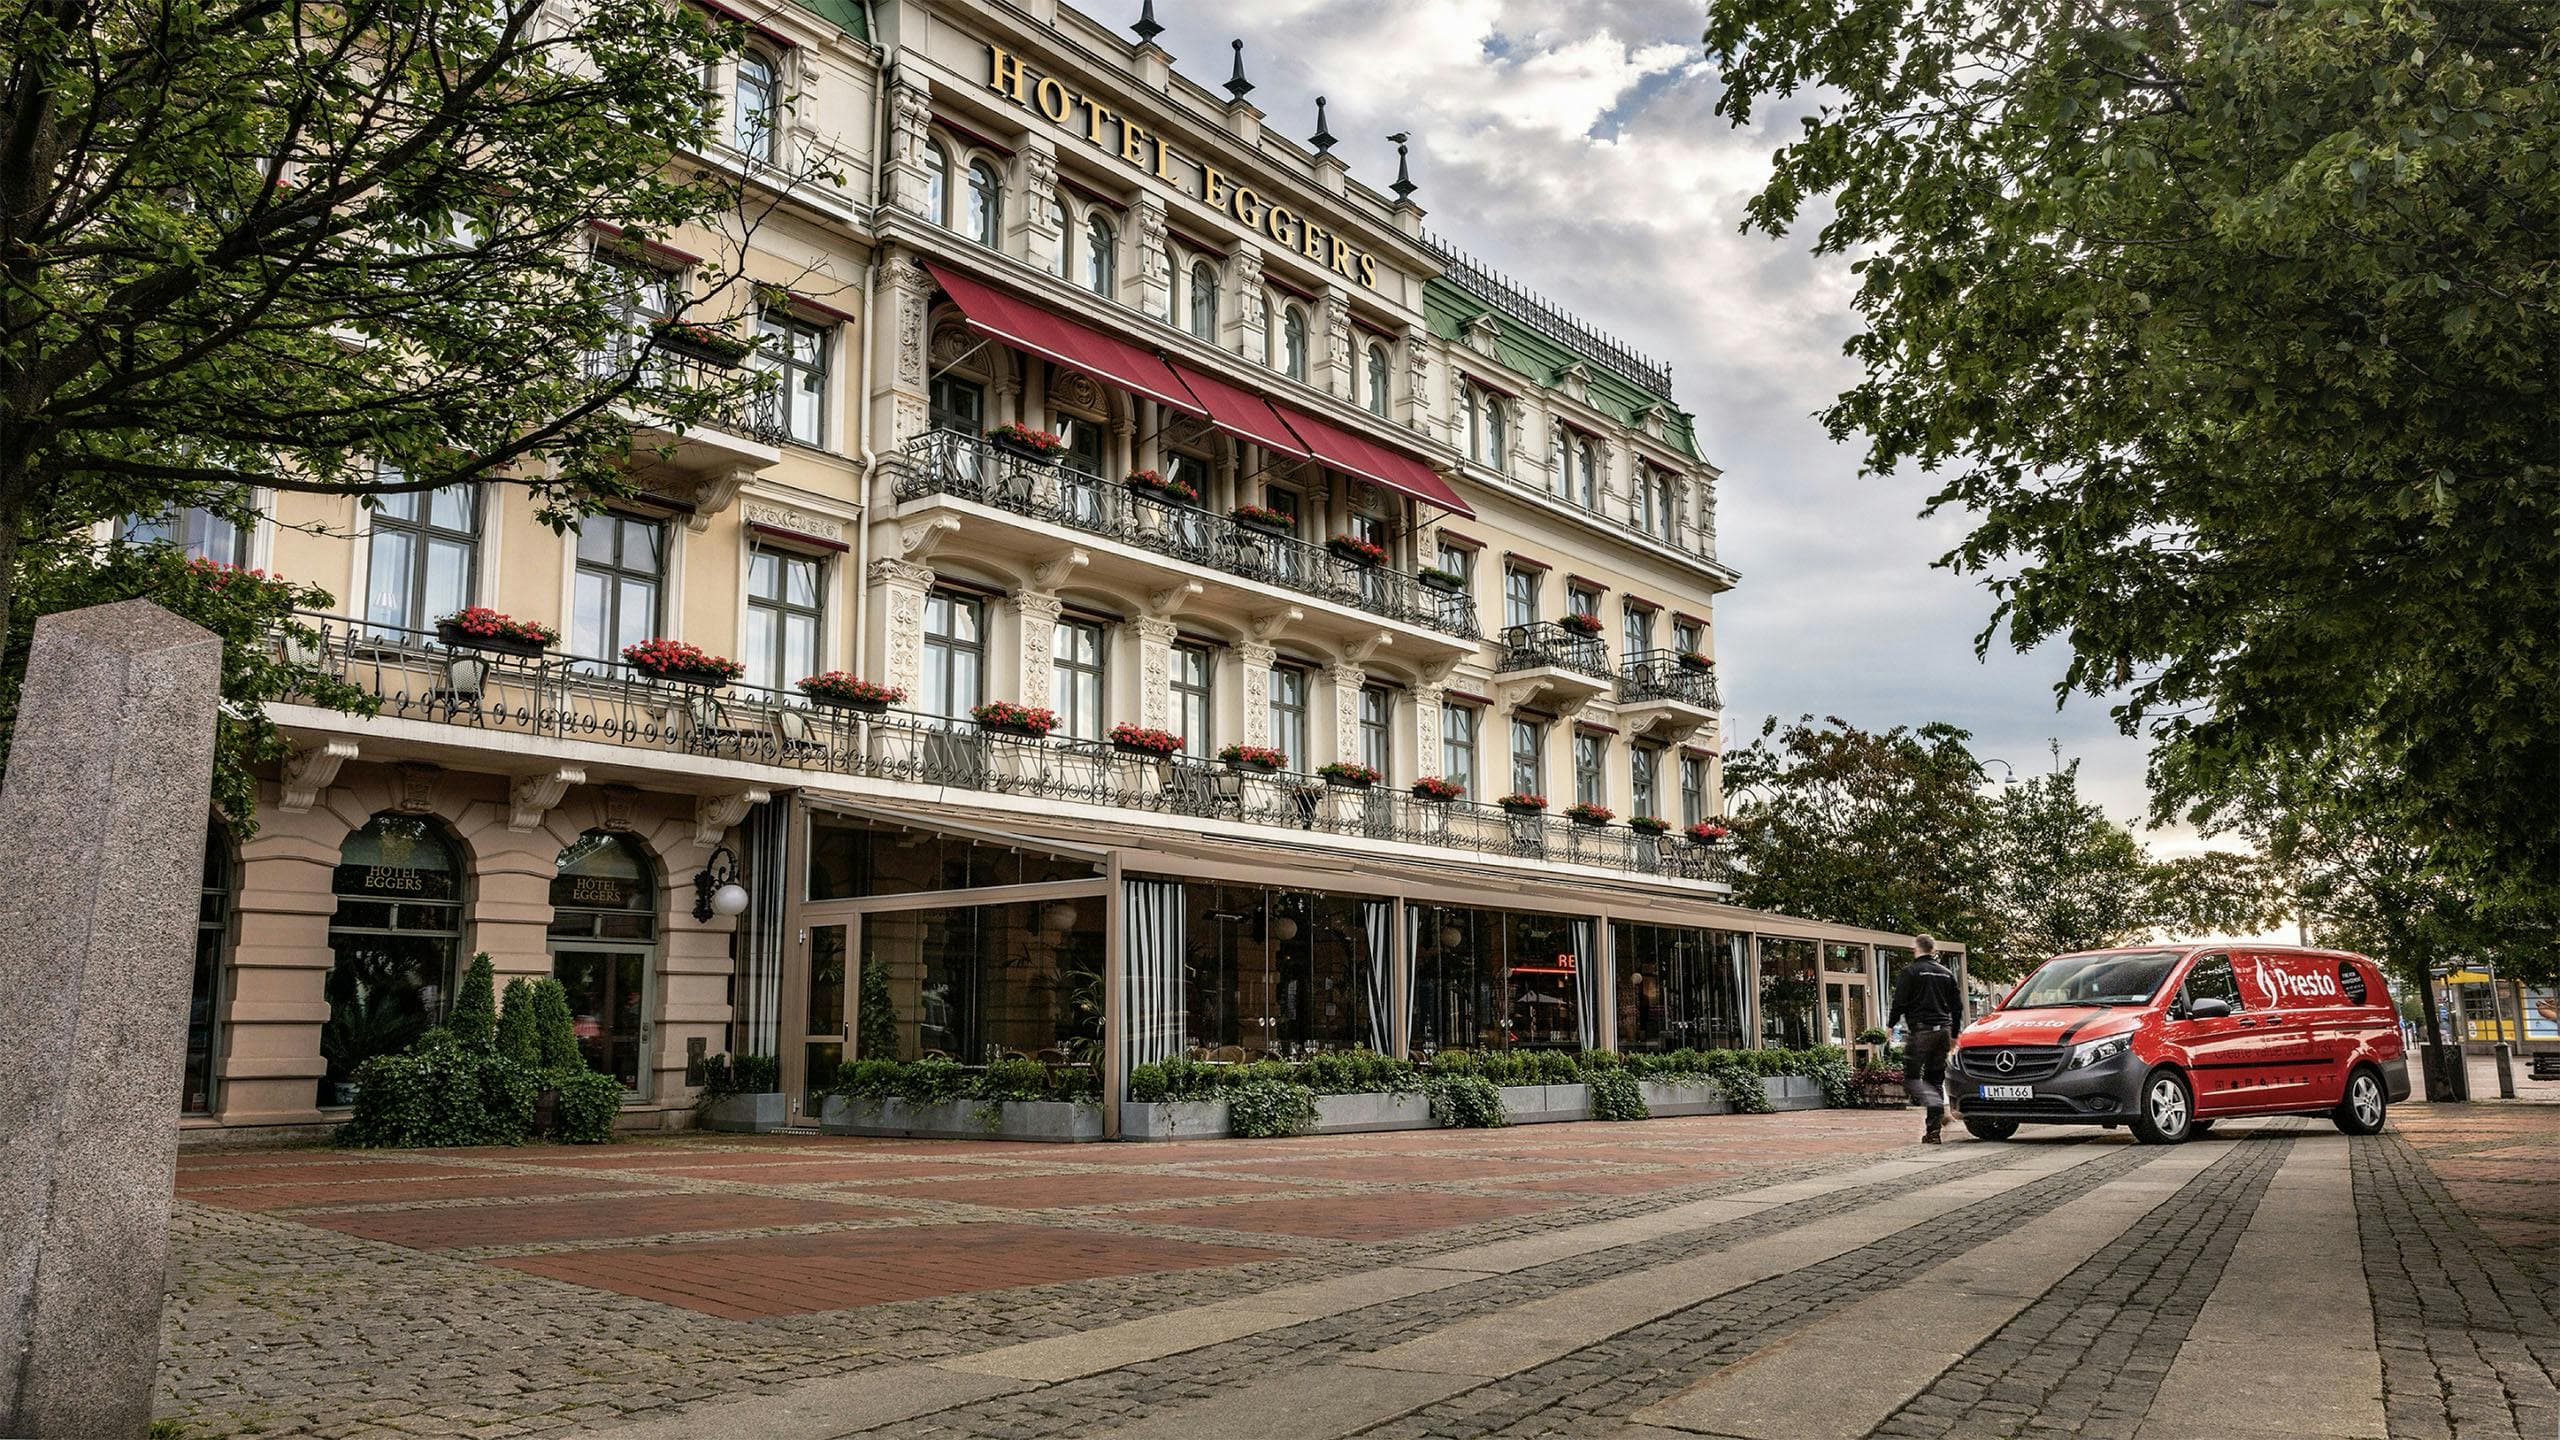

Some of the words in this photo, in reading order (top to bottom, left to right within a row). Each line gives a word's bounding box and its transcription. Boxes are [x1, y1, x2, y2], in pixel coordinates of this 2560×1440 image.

[988, 44, 1180, 187] HOTEL
[1202, 165, 1377, 290] EGGERS
[365, 876, 422, 890] EGGERS
[573, 889, 621, 901] EGGERS
[2273, 967, 2336, 996] Presto
[2010, 1086, 2028, 1097] 166
